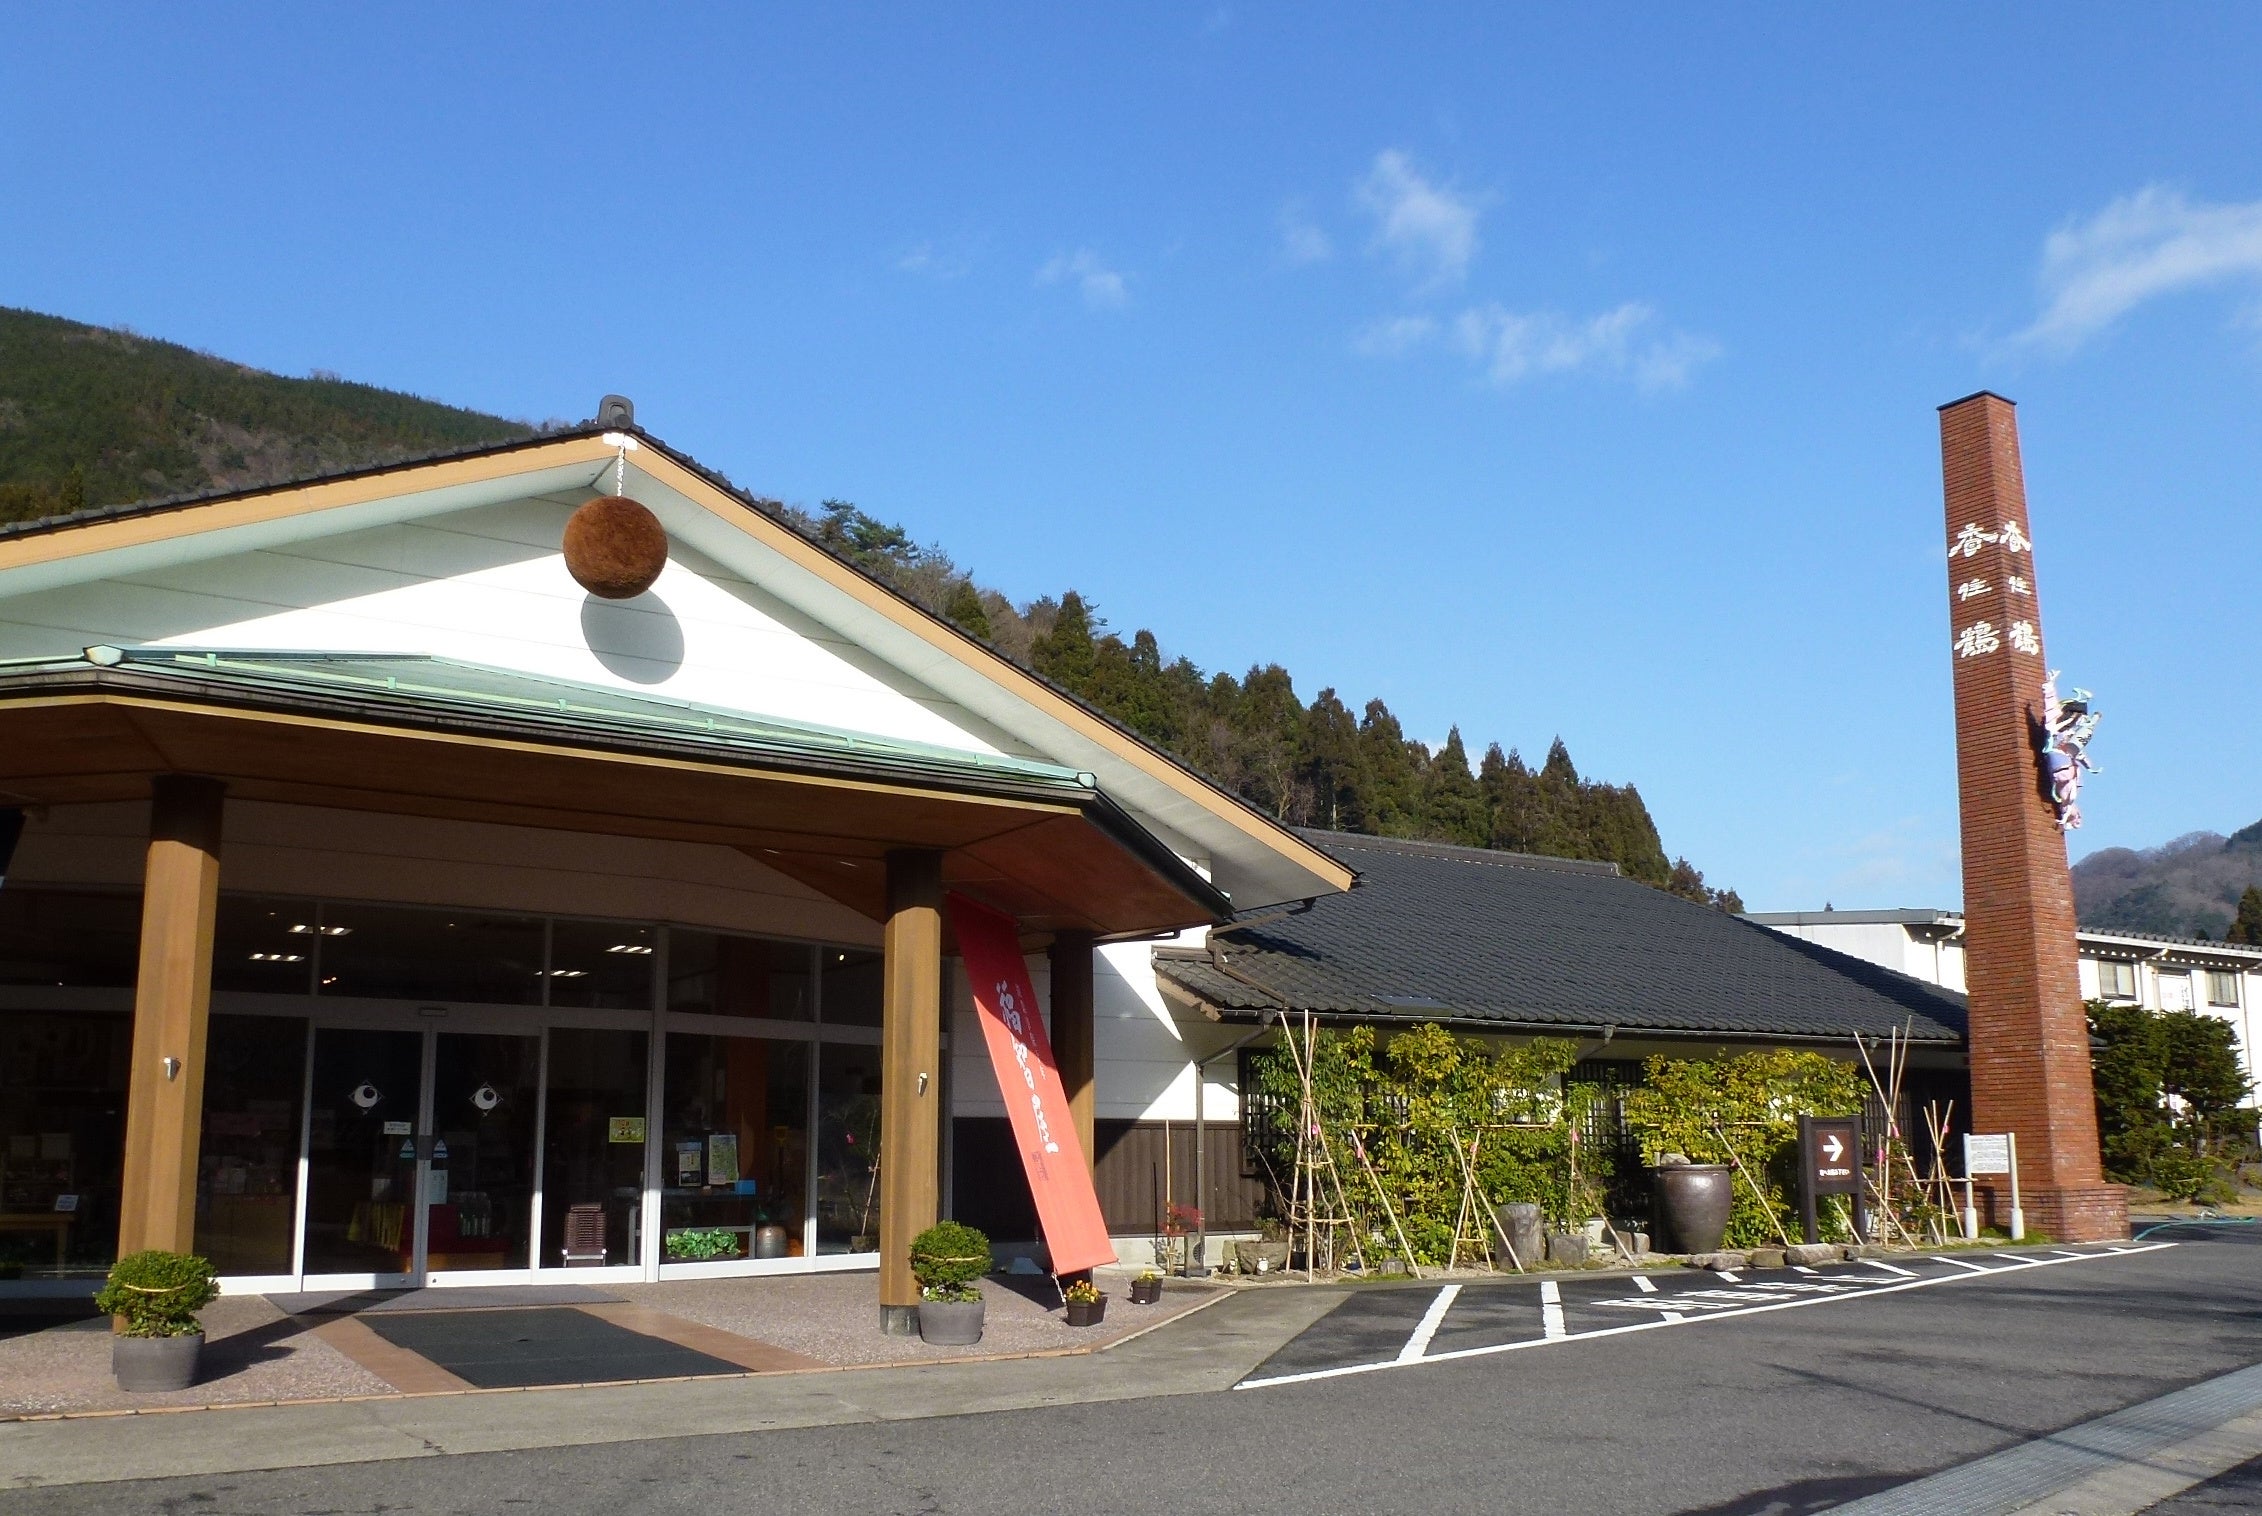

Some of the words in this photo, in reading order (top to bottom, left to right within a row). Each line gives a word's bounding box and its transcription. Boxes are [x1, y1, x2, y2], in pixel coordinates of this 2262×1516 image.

[1948, 523, 1999, 658] 香住鶴
[2000, 521, 2039, 656] 香住鶴
[1590, 1275, 1917, 1310] 駐車禁止
